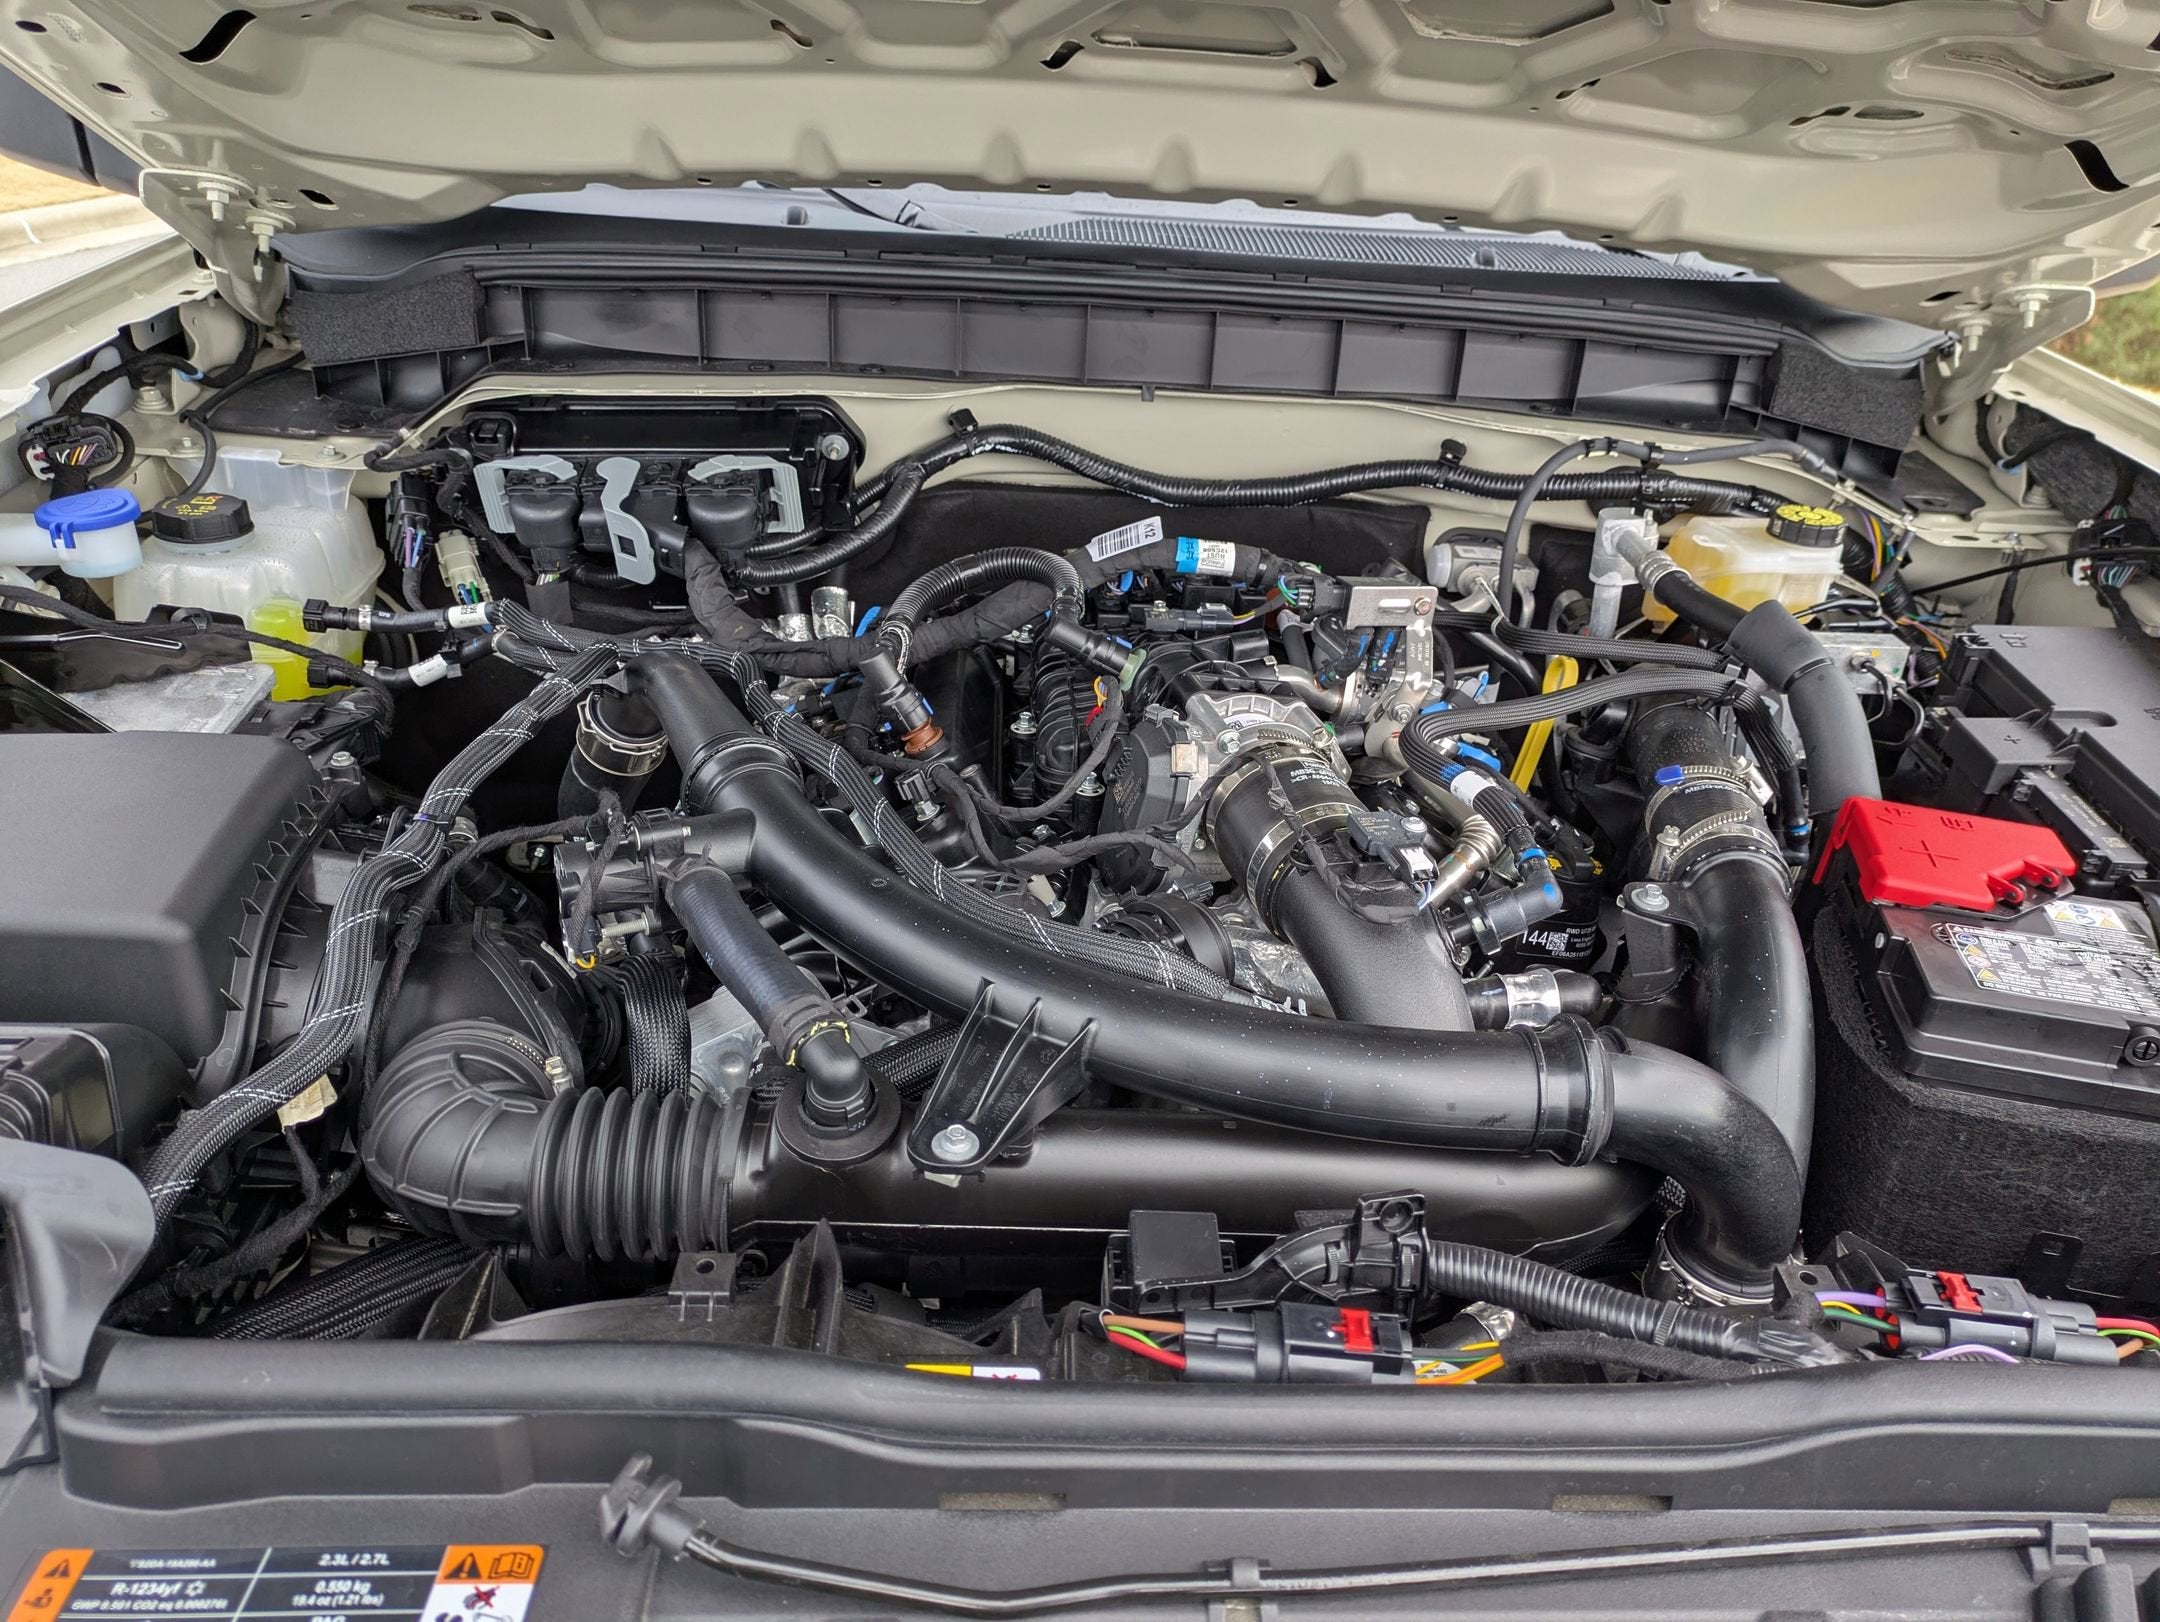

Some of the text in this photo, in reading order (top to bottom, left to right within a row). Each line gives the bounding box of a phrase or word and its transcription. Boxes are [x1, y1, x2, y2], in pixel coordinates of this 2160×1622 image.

[1144, 522, 1156, 539] K12
[1522, 930, 1549, 946] 144
[318, 1553, 349, 1567] 2.3L
[360, 1553, 390, 1567] 2.7L
[110, 1581, 184, 1598] R-1234yf
[353, 1580, 372, 1596] kg
